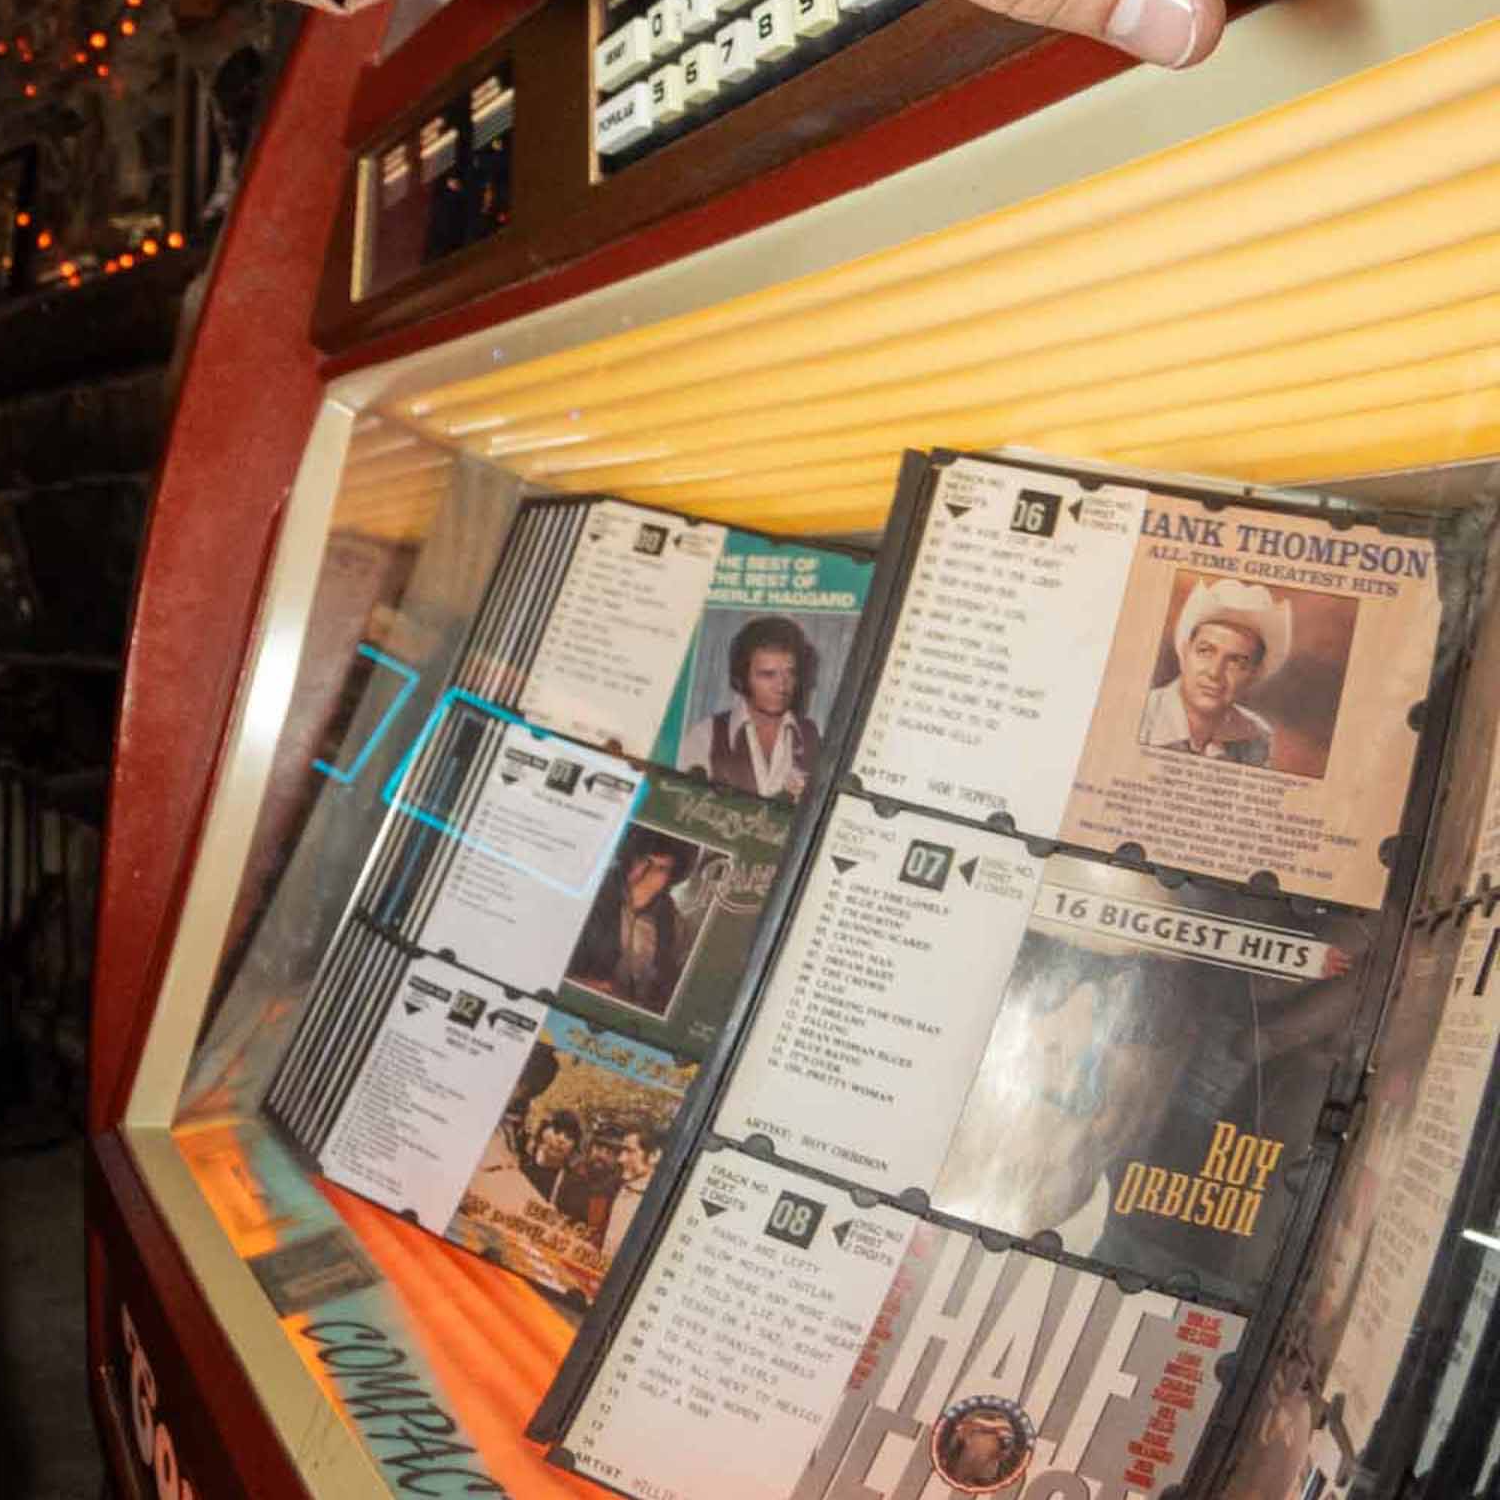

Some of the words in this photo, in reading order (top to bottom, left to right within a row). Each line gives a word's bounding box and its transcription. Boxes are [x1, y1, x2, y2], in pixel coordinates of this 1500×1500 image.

[651, 13, 663, 38] 0
[652, 82, 665, 106] 5
[685, 61, 697, 84] 6
[721, 38, 735, 63] 7
[758, 12, 773, 40] 8
[1148, 543, 1240, 576] ALL-TIME
[1243, 557, 1347, 590] GREATEST
[1352, 575, 1400, 598] HITS
[1235, 521, 1431, 580] THOMPSON
[902, 845, 948, 882] 07
[1053, 892, 1087, 919] 16
[1100, 905, 1229, 952] BIGGEST
[1239, 934, 1311, 968] HITS
[1201, 1121, 1284, 1191] ROY
[767, 1199, 813, 1236] 08
[1114, 1162, 1262, 1237] ORBISON
